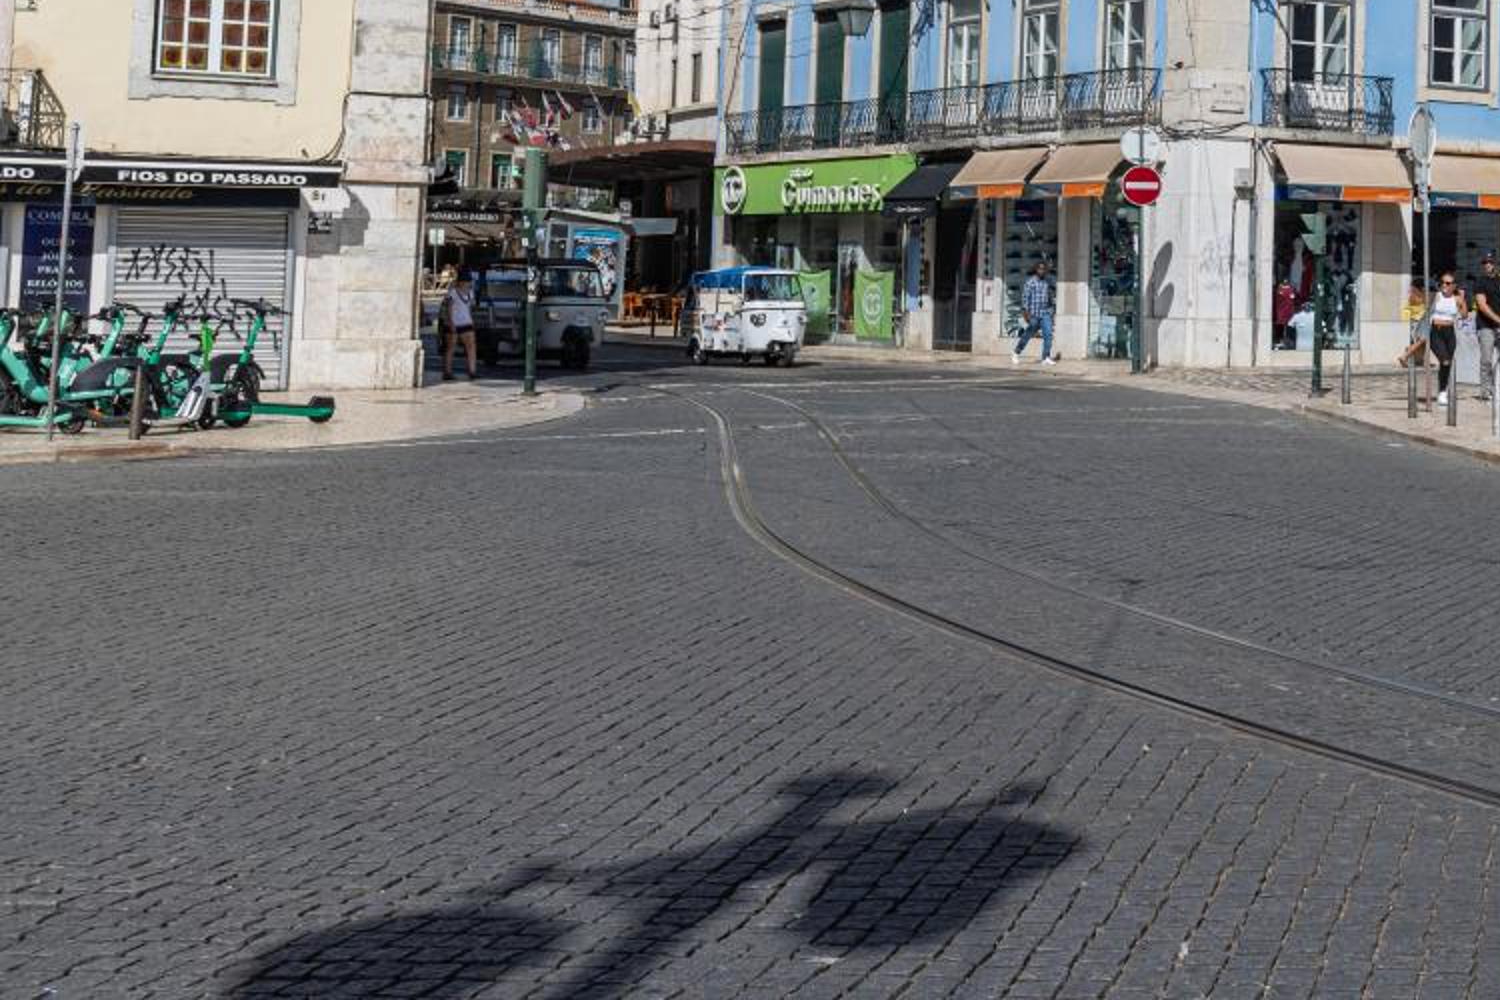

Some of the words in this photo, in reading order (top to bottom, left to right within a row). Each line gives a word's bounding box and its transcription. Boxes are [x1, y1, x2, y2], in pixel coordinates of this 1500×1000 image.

[118, 170, 168, 183] FIOS
[175, 171, 204, 184] DO
[211, 172, 307, 185] PASSADO
[37, 265, 75, 274] PRAA
[27, 278, 84, 288] RELÓIOS
